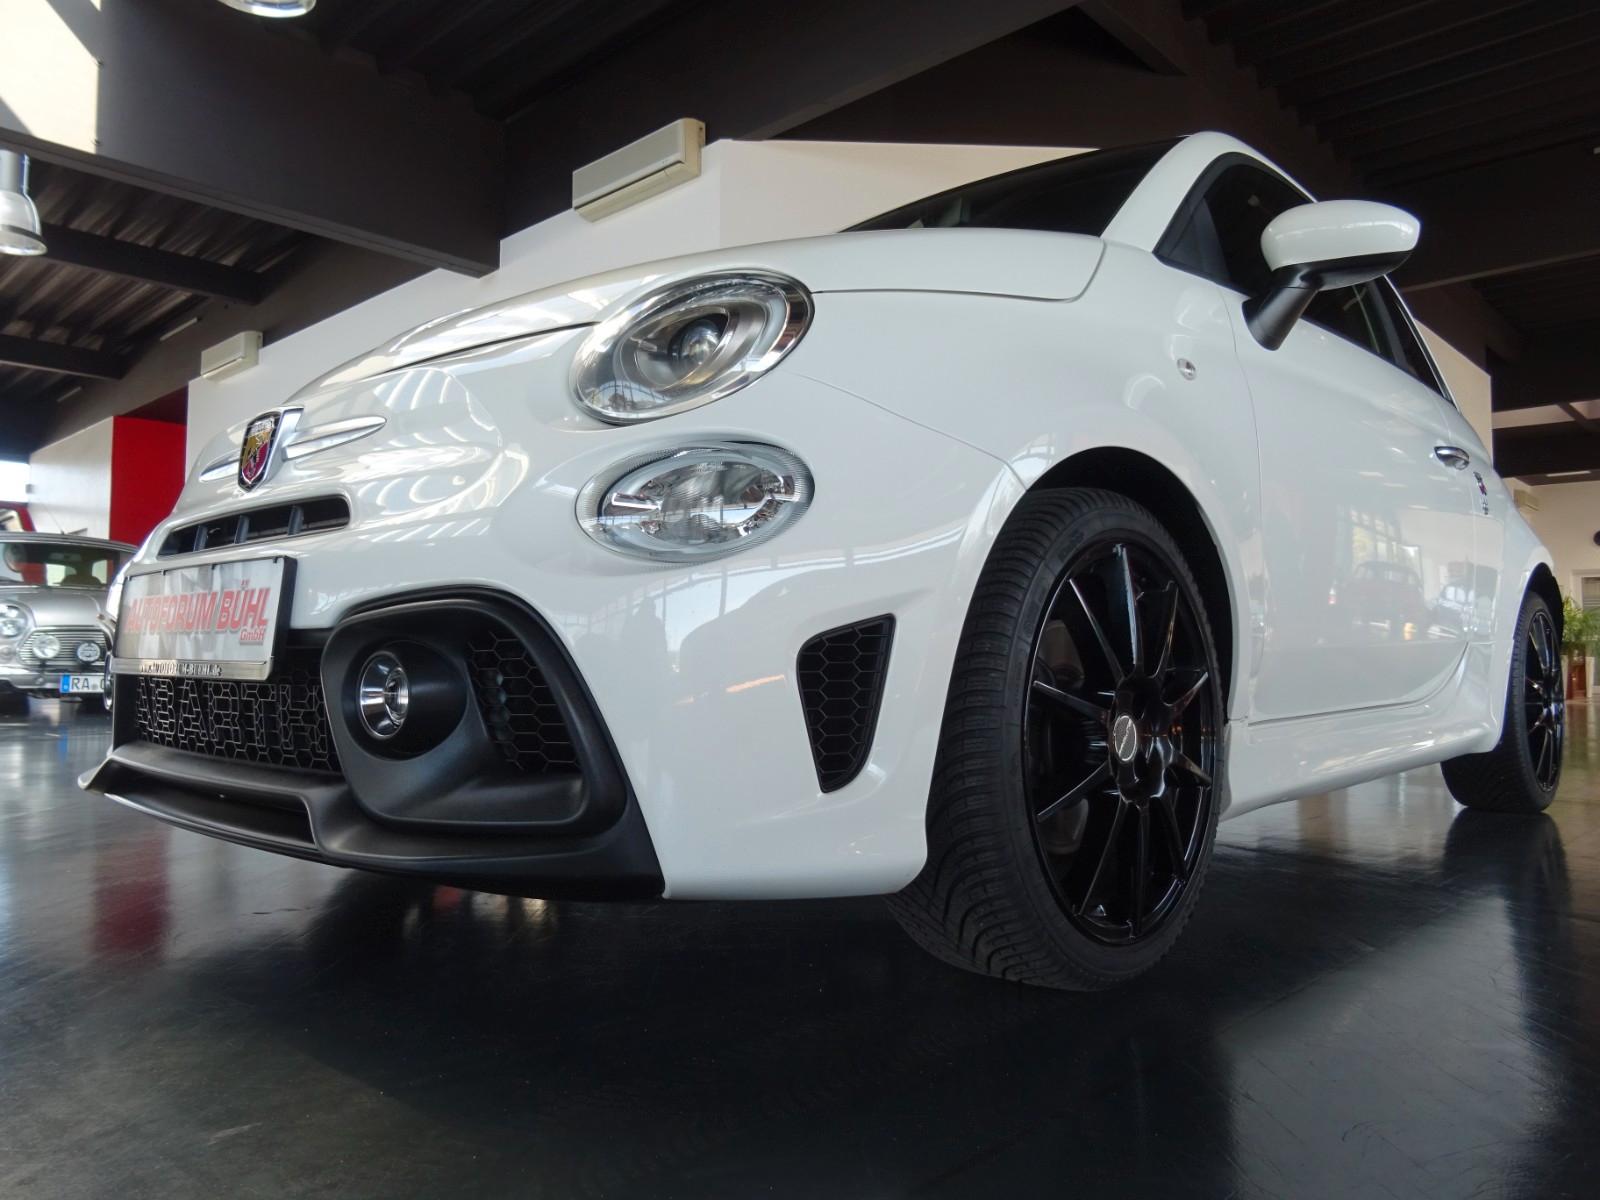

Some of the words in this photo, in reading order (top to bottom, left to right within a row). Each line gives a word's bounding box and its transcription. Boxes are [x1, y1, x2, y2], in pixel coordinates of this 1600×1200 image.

[125, 591, 218, 632] AUTOFORUM
[216, 579, 271, 631] BÜHL
[240, 628, 265, 641] GmbH
[71, 677, 90, 690] RA
